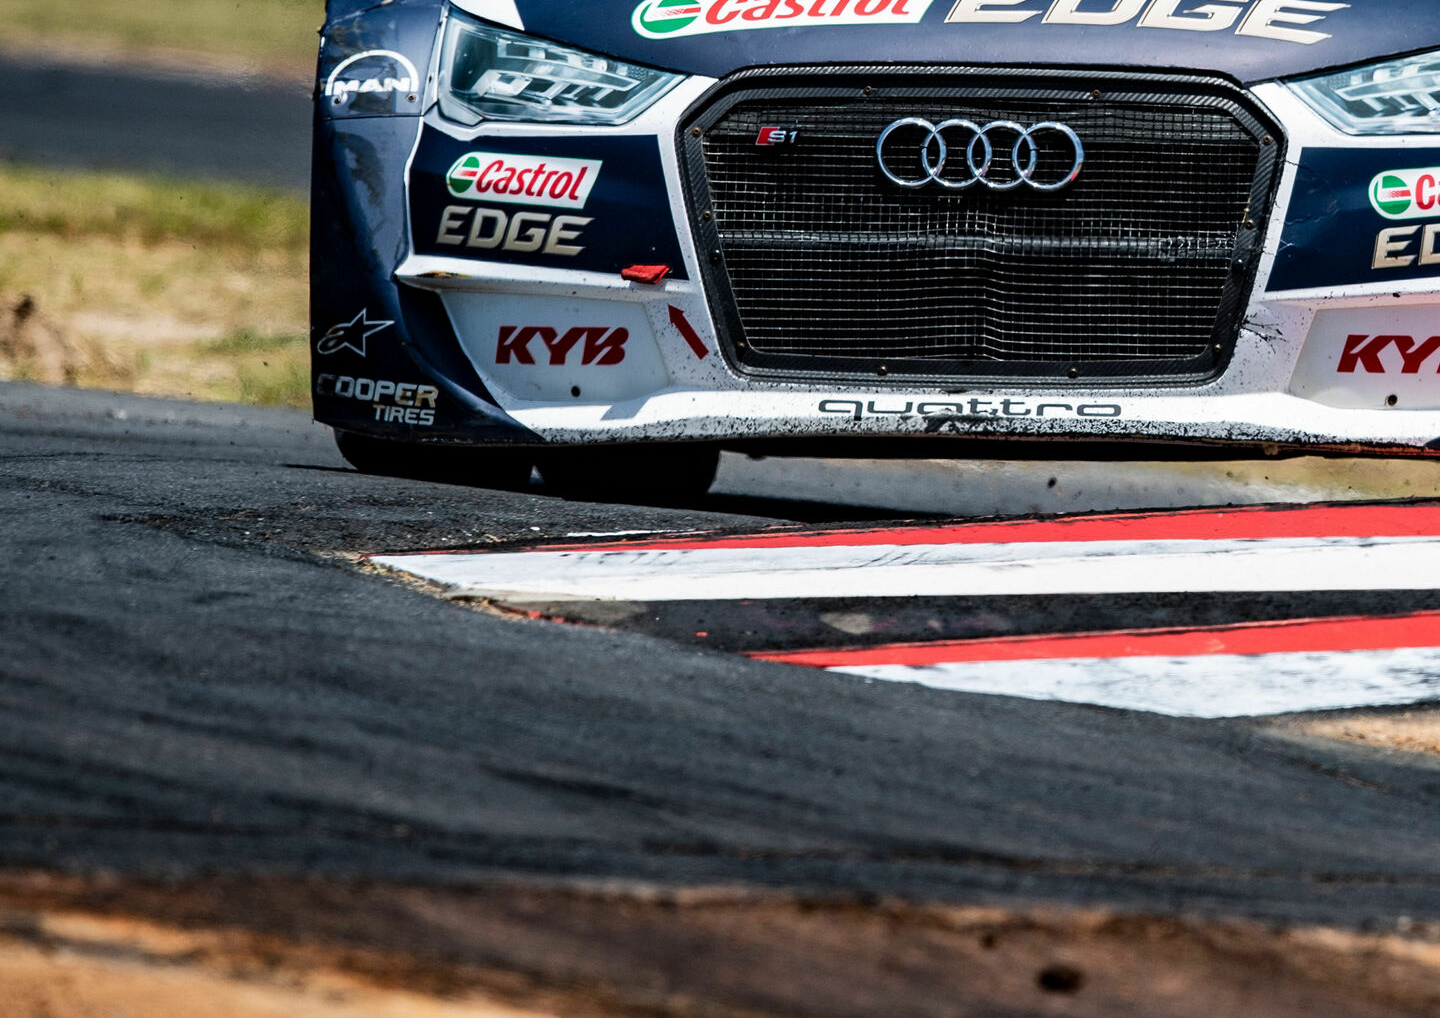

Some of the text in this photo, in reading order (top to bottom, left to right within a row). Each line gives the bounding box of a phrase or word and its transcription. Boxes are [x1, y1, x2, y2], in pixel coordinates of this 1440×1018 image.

[333, 77, 411, 95] MAN
[768, 129, 798, 144] S1
[475, 159, 590, 201] Castrol
[437, 206, 595, 255] EDGE
[495, 326, 630, 366] KYB
[316, 373, 439, 408] COOPER
[372, 403, 436, 426] TIRES
[818, 398, 1122, 418] quattro
